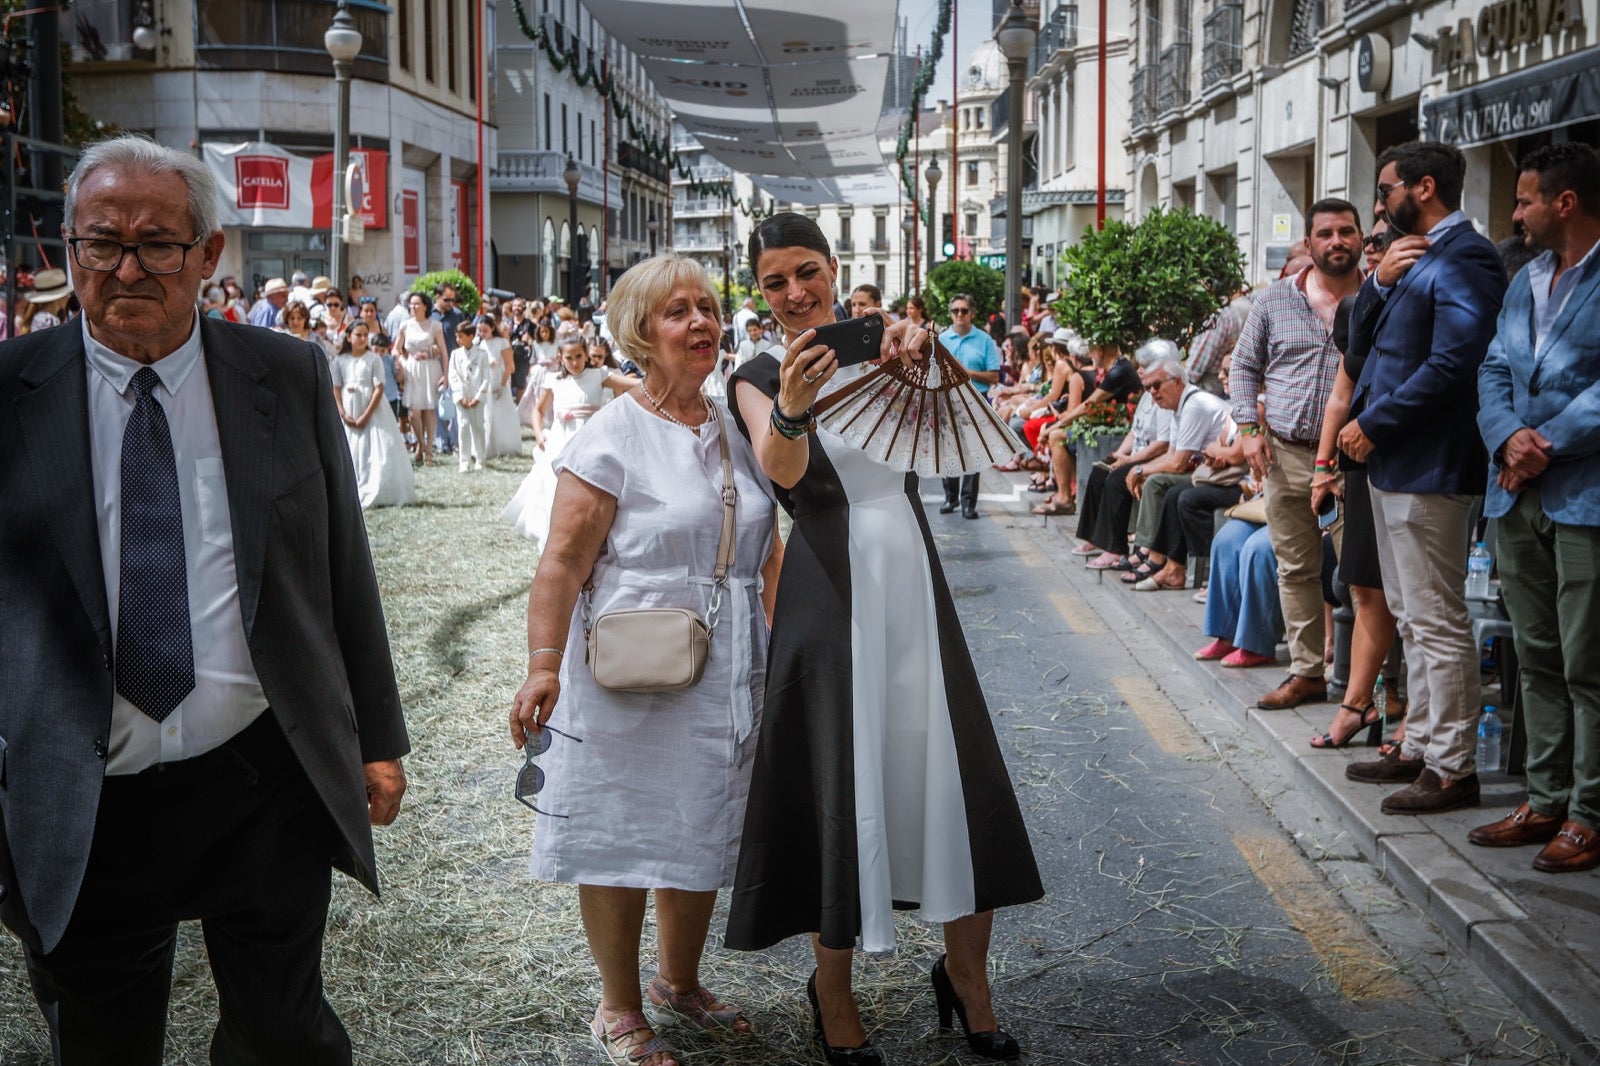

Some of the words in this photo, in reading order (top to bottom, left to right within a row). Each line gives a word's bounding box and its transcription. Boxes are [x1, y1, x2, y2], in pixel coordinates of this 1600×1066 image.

[1436, 18, 1476, 68] LA
[1477, 0, 1585, 57] CUEVA
[1463, 101, 1512, 141] CUEVA
[242, 176, 283, 187] CATELLA
